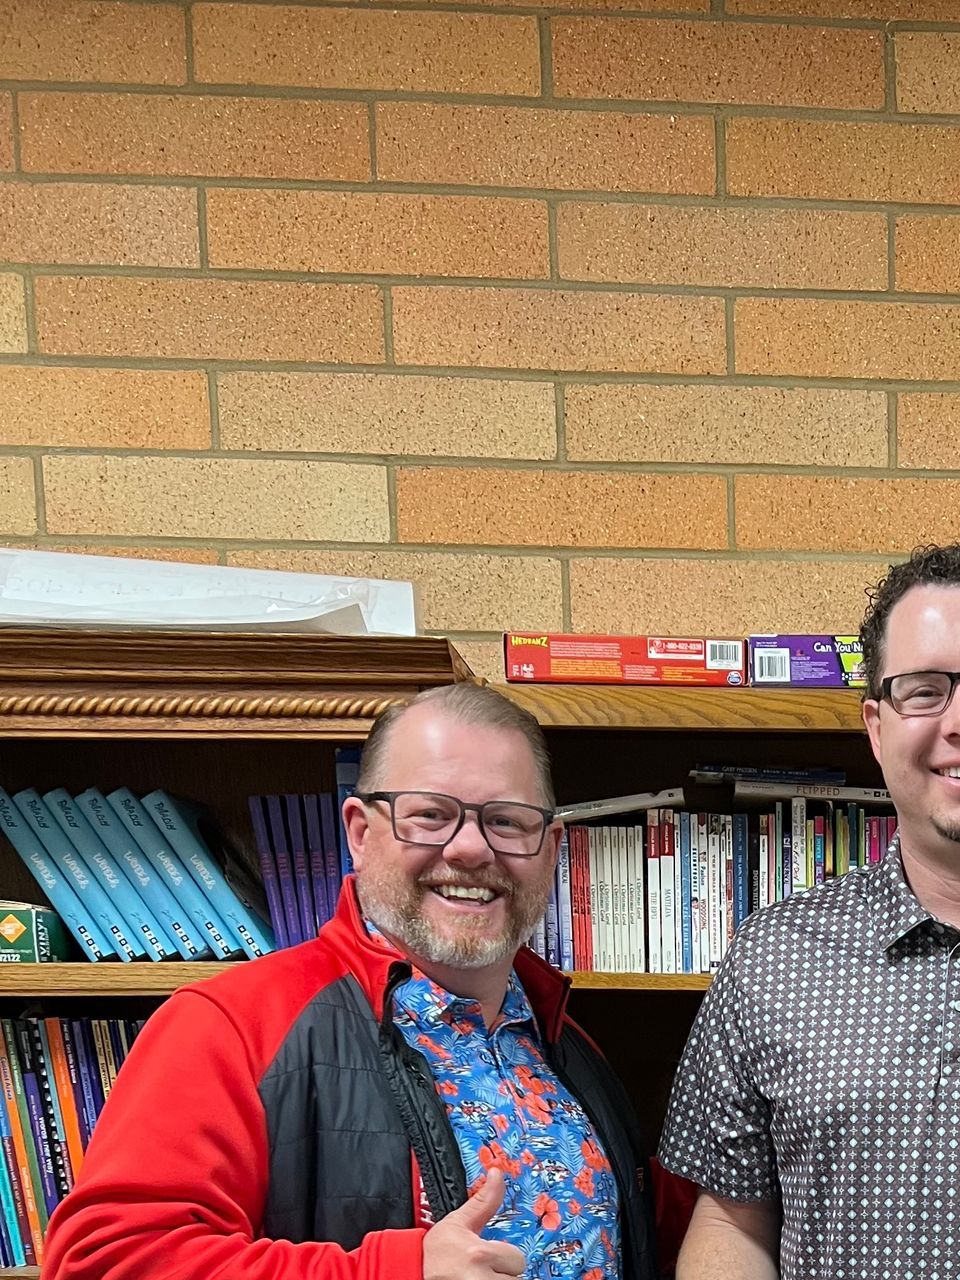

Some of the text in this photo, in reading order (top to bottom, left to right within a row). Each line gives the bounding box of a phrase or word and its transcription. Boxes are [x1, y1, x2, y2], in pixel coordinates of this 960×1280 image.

[814, 642, 850, 653] Can You
[796, 785, 840, 797] FLIPPED
[37, 914, 47, 955] VINYL
[0, 953, 21, 963] 2122
[0, 1056, 10, 1081] Content
[100, 1062, 109, 1088] SURVIVAL
[38, 1117, 54, 1174] Words Their Way
